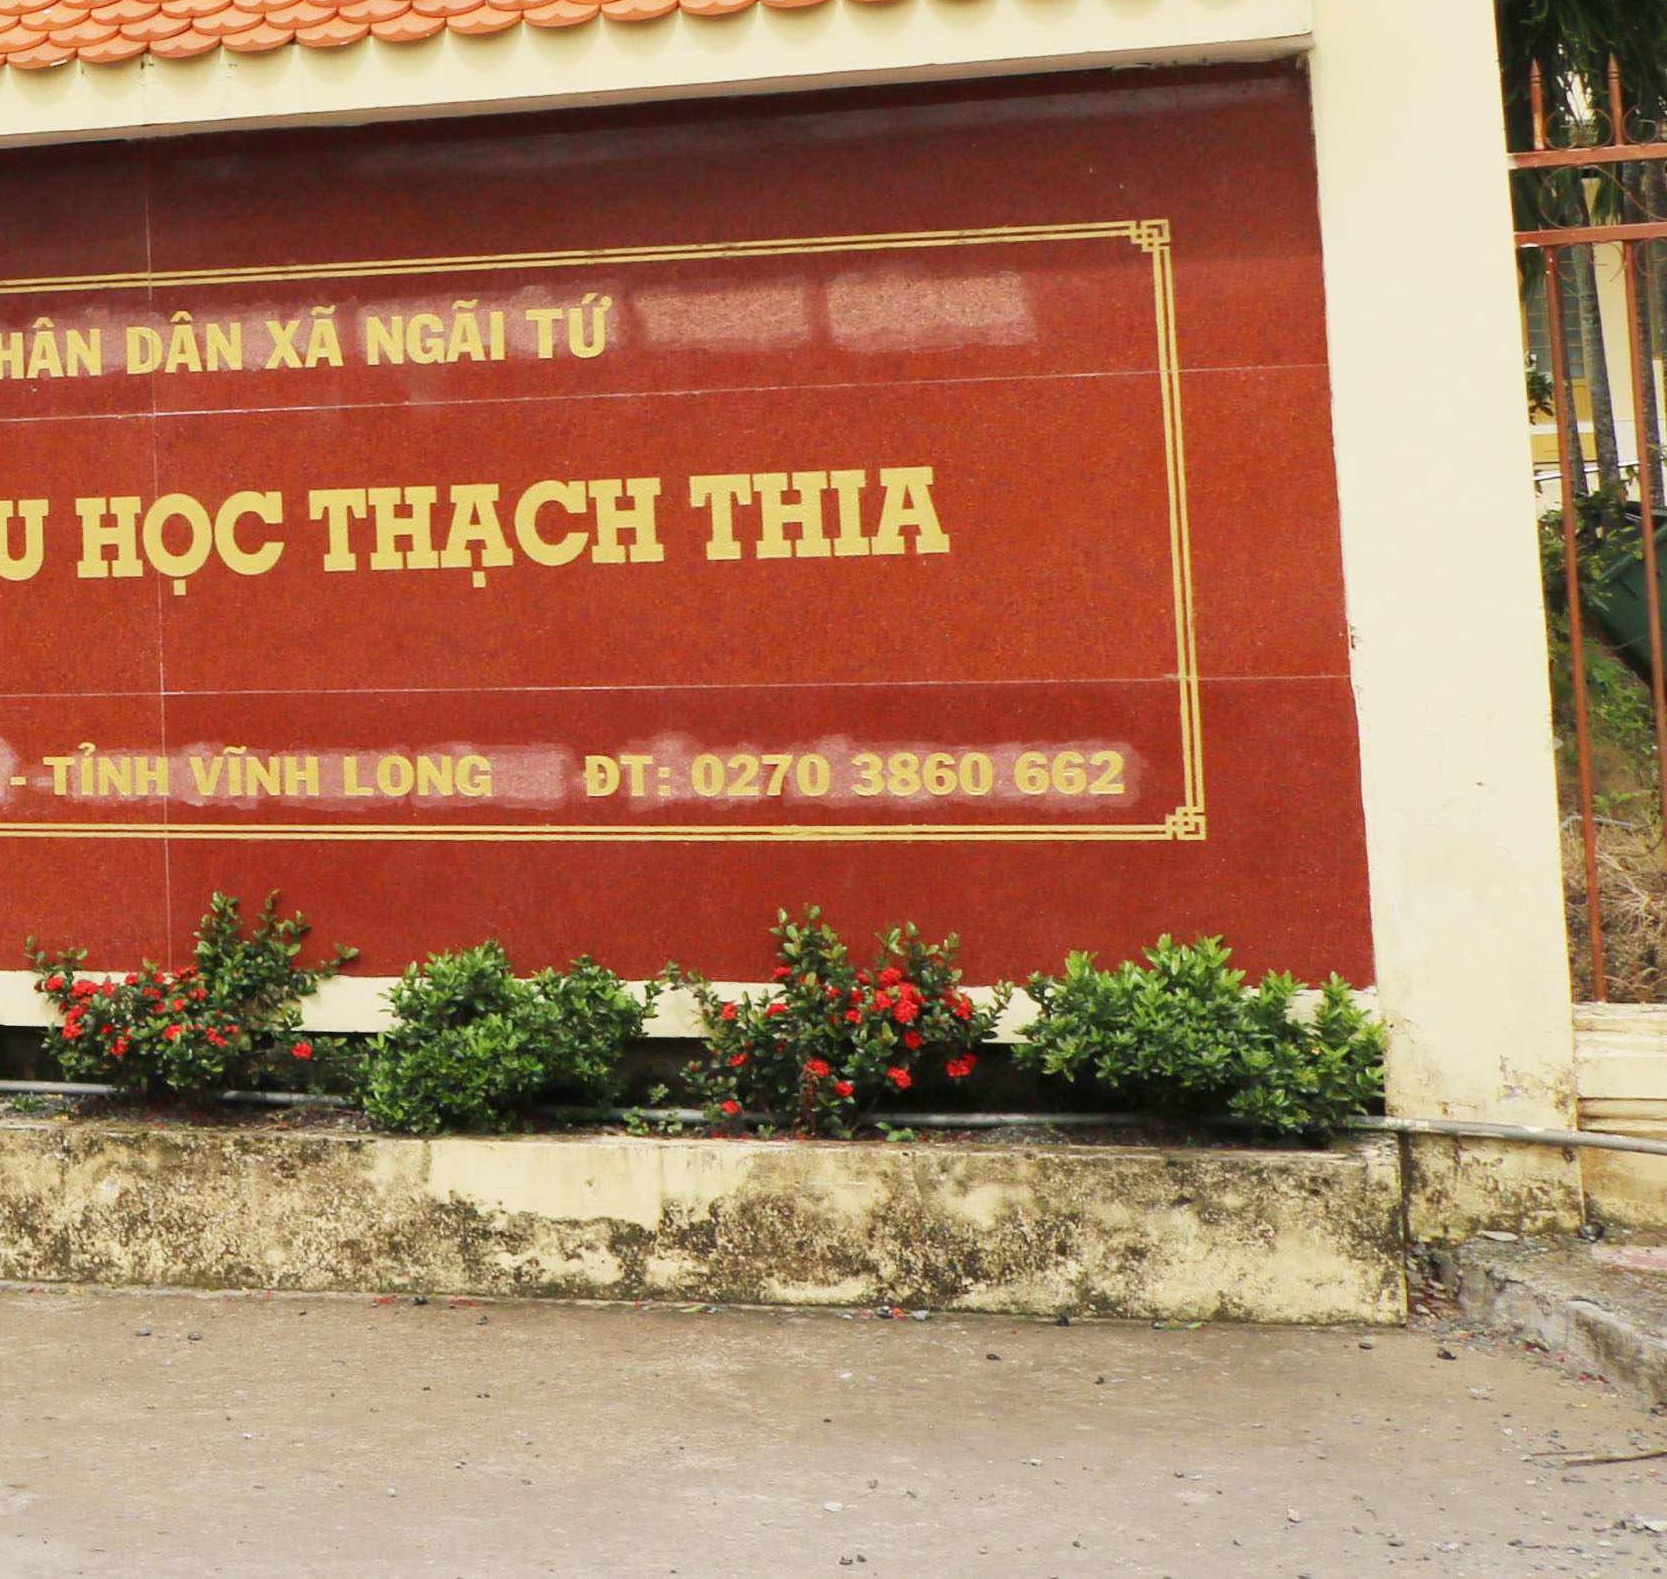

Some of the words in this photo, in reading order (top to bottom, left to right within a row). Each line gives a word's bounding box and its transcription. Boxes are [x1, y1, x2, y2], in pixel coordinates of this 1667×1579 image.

[124, 310, 244, 376] DÂN
[266, 306, 344, 369] XÃ
[365, 299, 508, 366] NGÃI
[524, 292, 613, 360] TỨ
[74, 490, 285, 596] HỌC
[308, 477, 665, 588] THẠCH
[688, 466, 951, 561] THIA
[42, 742, 172, 796] TỈNH
[189, 745, 323, 796] VĨNH
[342, 753, 493, 797] LONG
[582, 753, 673, 796] ĐT:
[690, 753, 832, 797] 0270
[851, 751, 996, 797] 3860
[1014, 749, 1126, 797] 662
